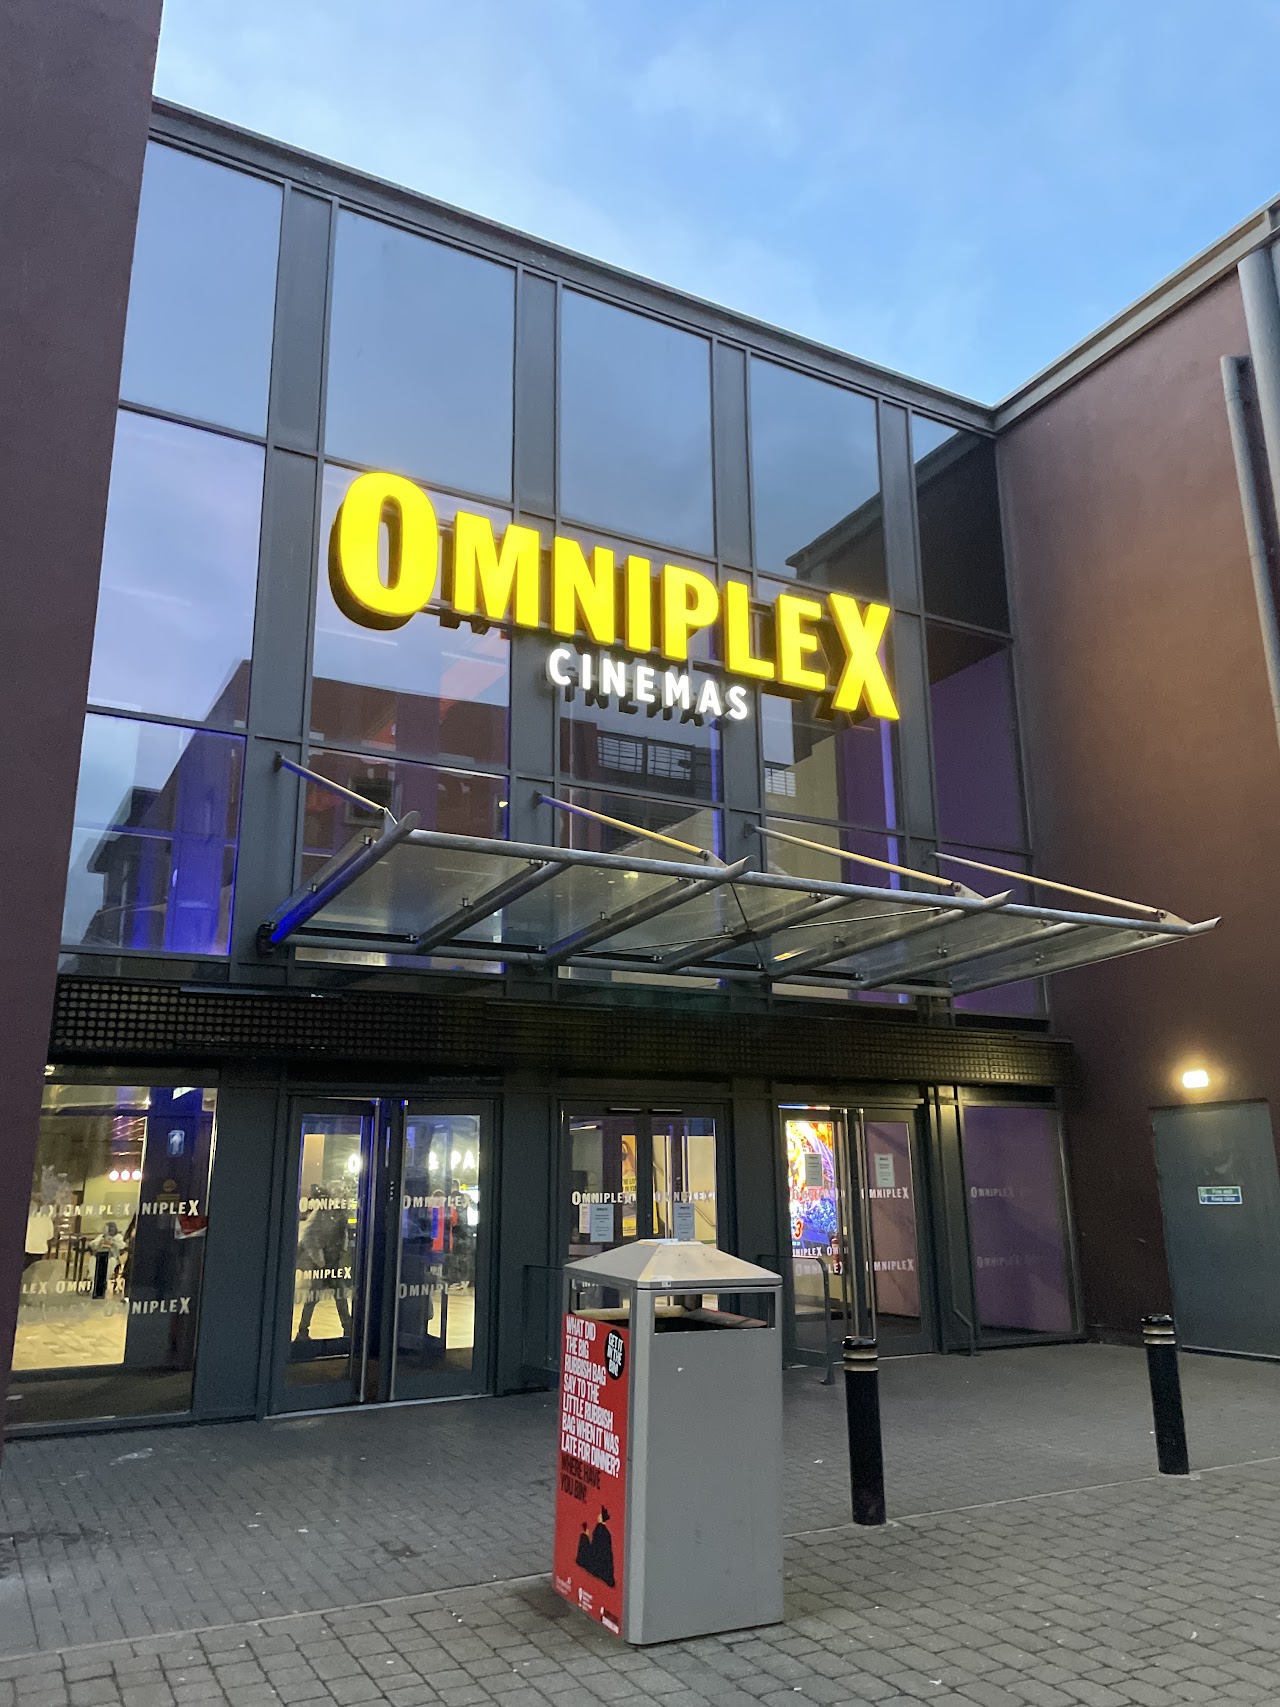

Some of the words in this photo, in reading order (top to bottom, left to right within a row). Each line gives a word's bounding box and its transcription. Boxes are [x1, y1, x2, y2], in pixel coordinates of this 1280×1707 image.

[337, 471, 900, 721] OMNIPLEX
[546, 648, 748, 722] CINEMAS
[571, 1190, 632, 1206] OMNIPLEX
[295, 1266, 351, 1282] OMNIPLEX
[566, 1316, 583, 1335] WHAT
[585, 1320, 596, 1341] DID
[565, 1335, 578, 1356] THE
[578, 1339, 589, 1360] BIG
[564, 1354, 591, 1380] RUBBISH
[592, 1365, 606, 1386] BAG
[564, 1373, 577, 1394] SAY
[577, 1378, 586, 1399] TO
[587, 1382, 600, 1404] THE
[563, 1393, 584, 1418] LITTLE
[585, 1403, 613, 1431] RUBBISH
[562, 1412, 576, 1433] BAG
[576, 1419, 596, 1443] WHEN
[596, 1427, 604, 1448] IT
[604, 1430, 619, 1456] WAS
[562, 1432, 577, 1457] LATE
[578, 1440, 591, 1463] FOR
[591, 1447, 620, 1478] DINNER?
